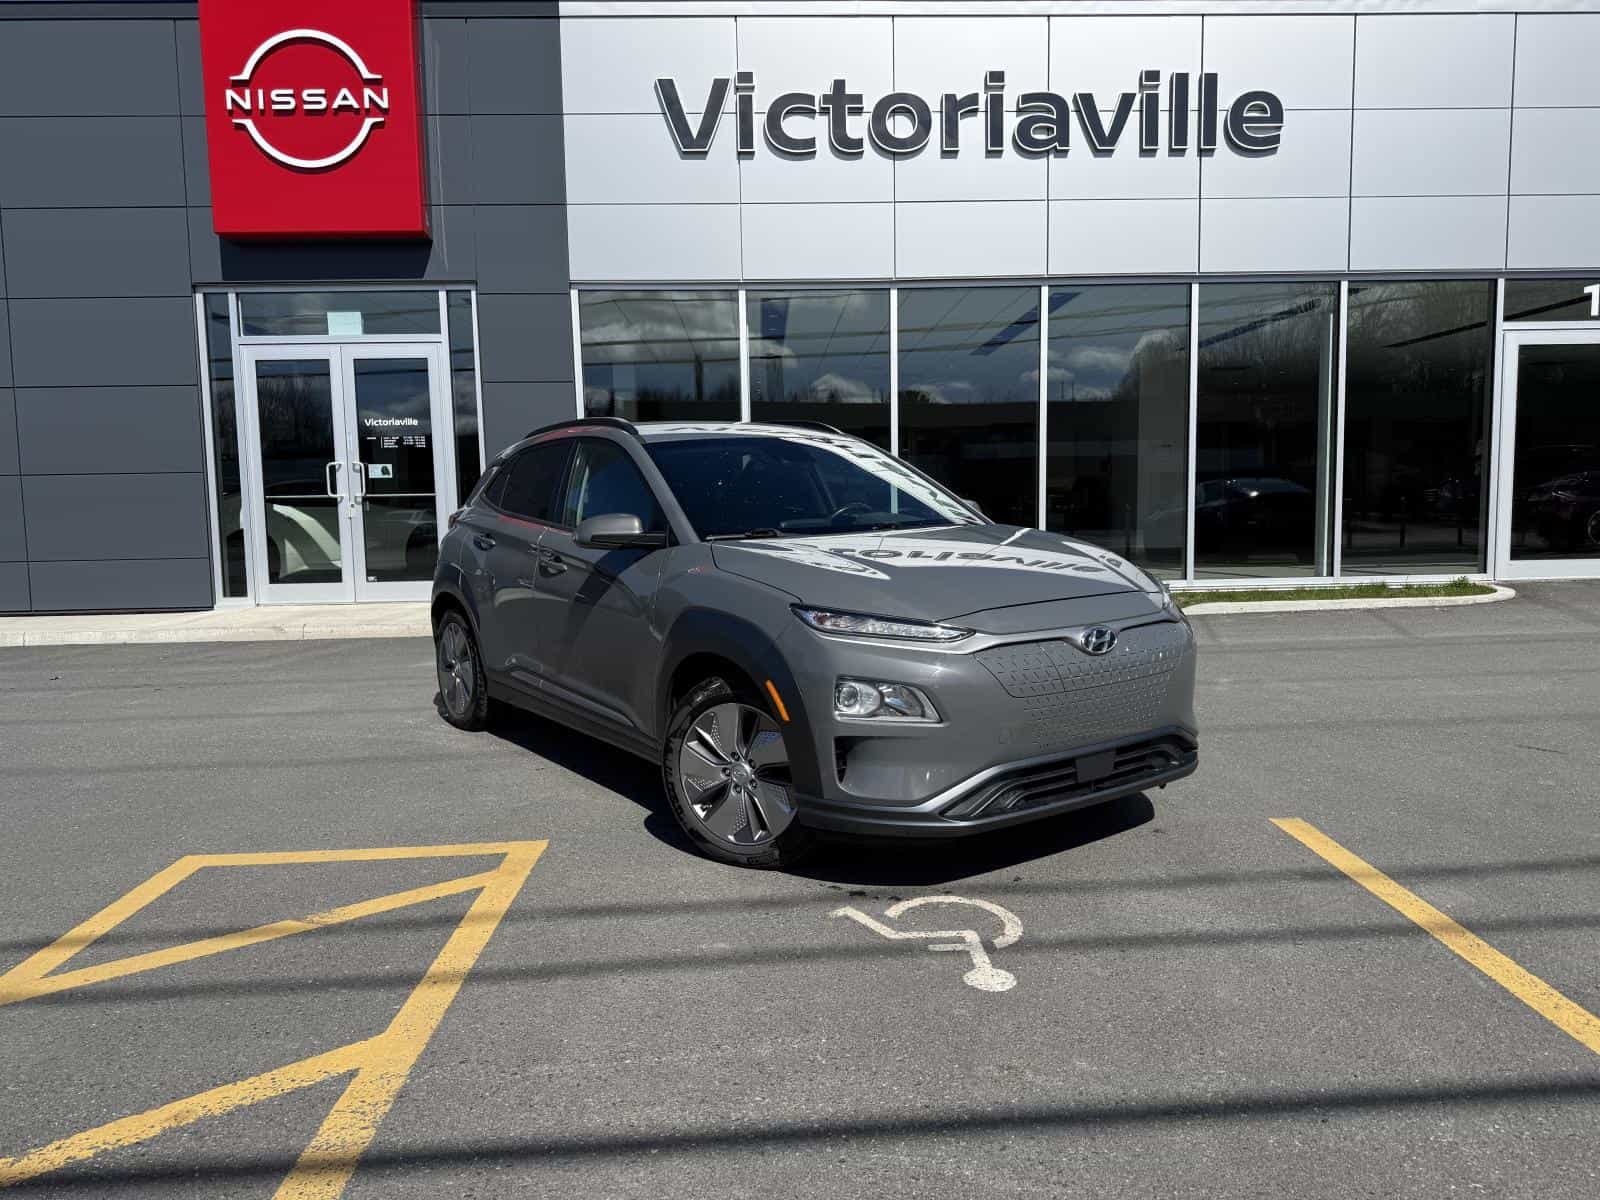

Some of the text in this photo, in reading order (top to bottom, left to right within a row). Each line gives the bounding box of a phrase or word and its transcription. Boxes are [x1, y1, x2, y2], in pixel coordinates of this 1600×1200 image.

[225, 87, 389, 111] NISSAN
[654, 70, 1284, 155] Victoriaville
[364, 417, 418, 426] Victoriaville
